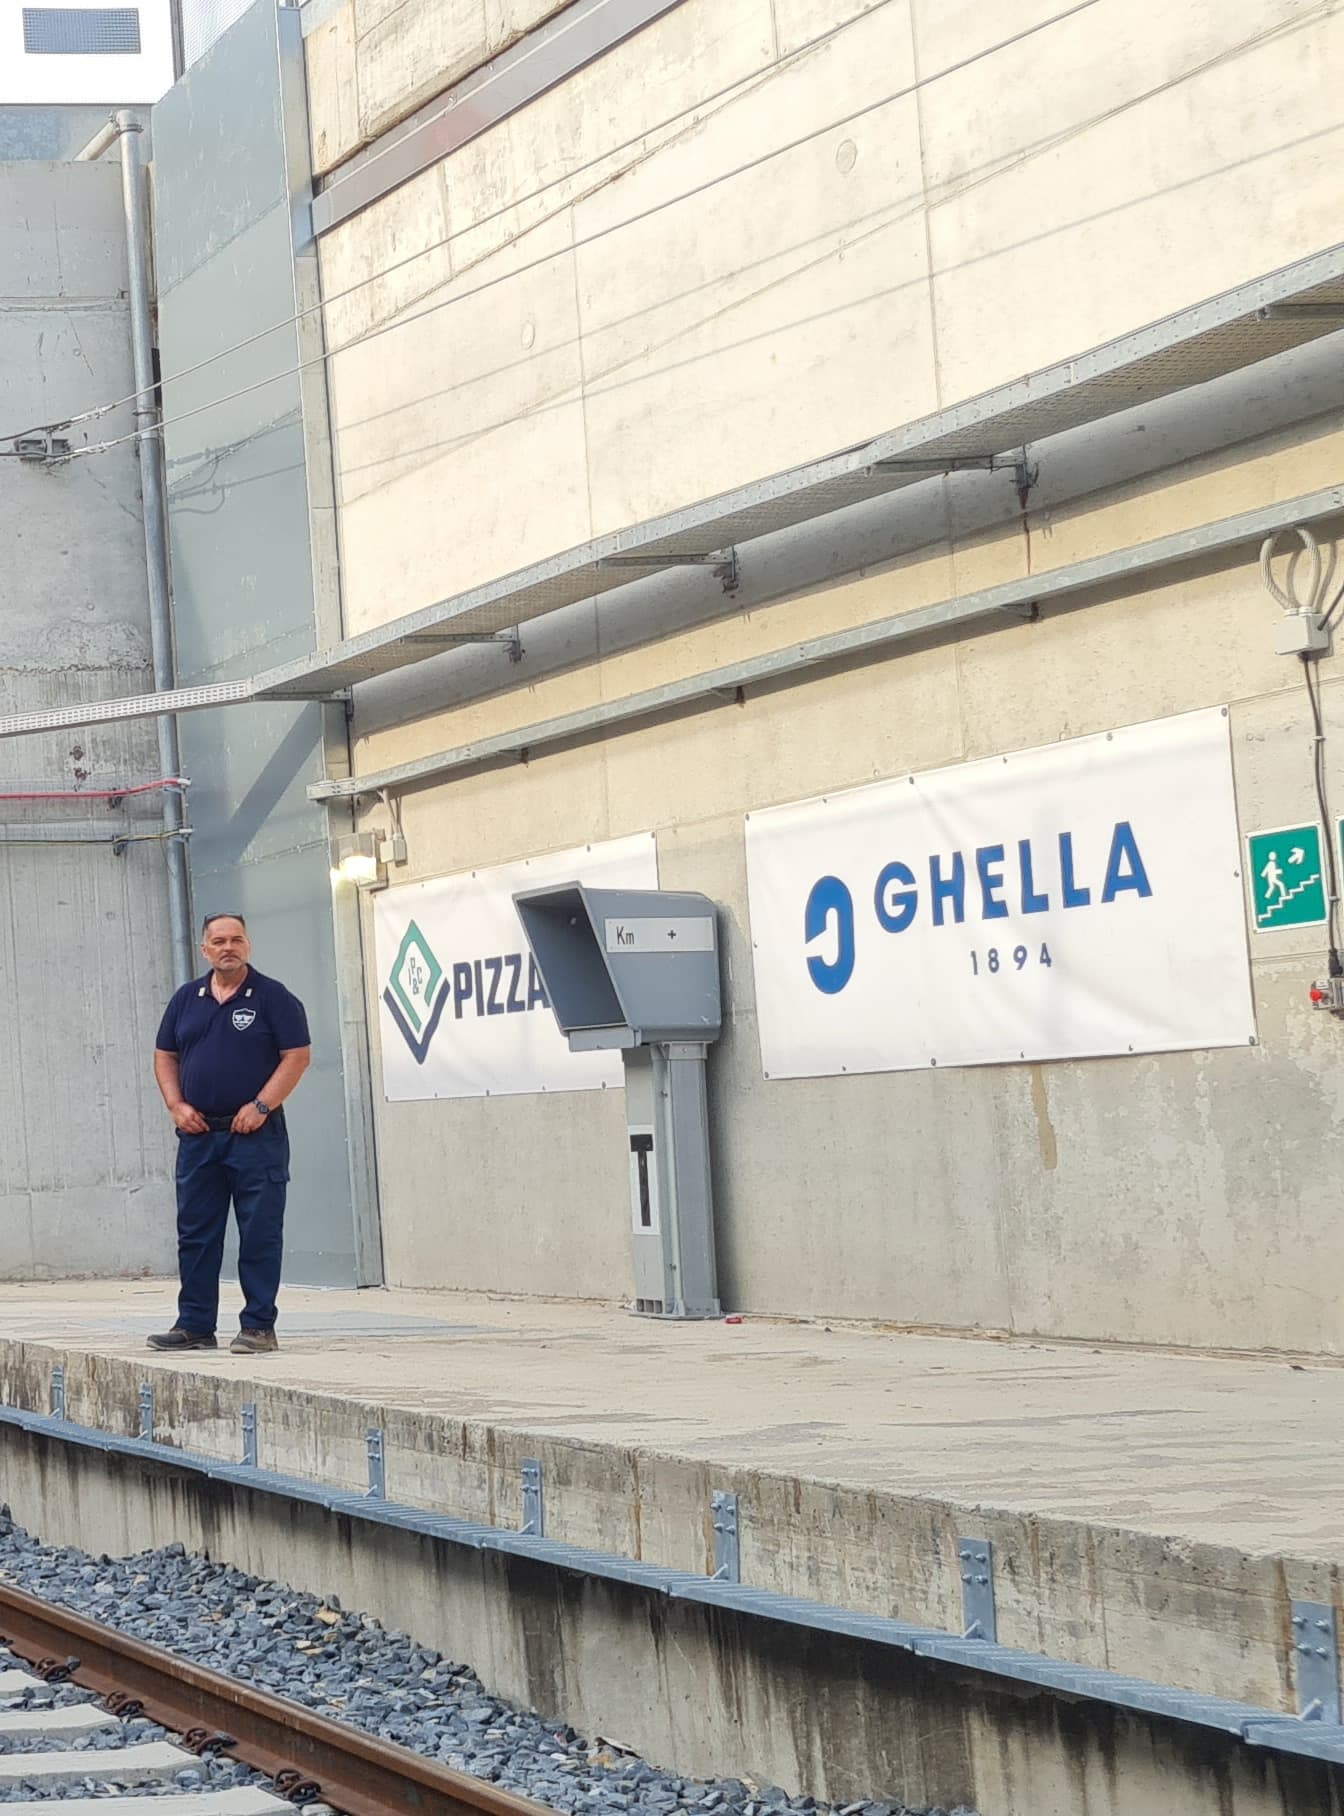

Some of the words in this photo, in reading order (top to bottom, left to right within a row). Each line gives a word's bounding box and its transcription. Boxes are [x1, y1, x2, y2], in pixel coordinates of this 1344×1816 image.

[874, 821, 1153, 933] GHELLA
[616, 926, 635, 945] Km
[970, 942, 1052, 975] 1894
[452, 951, 552, 1020] PIZZA
